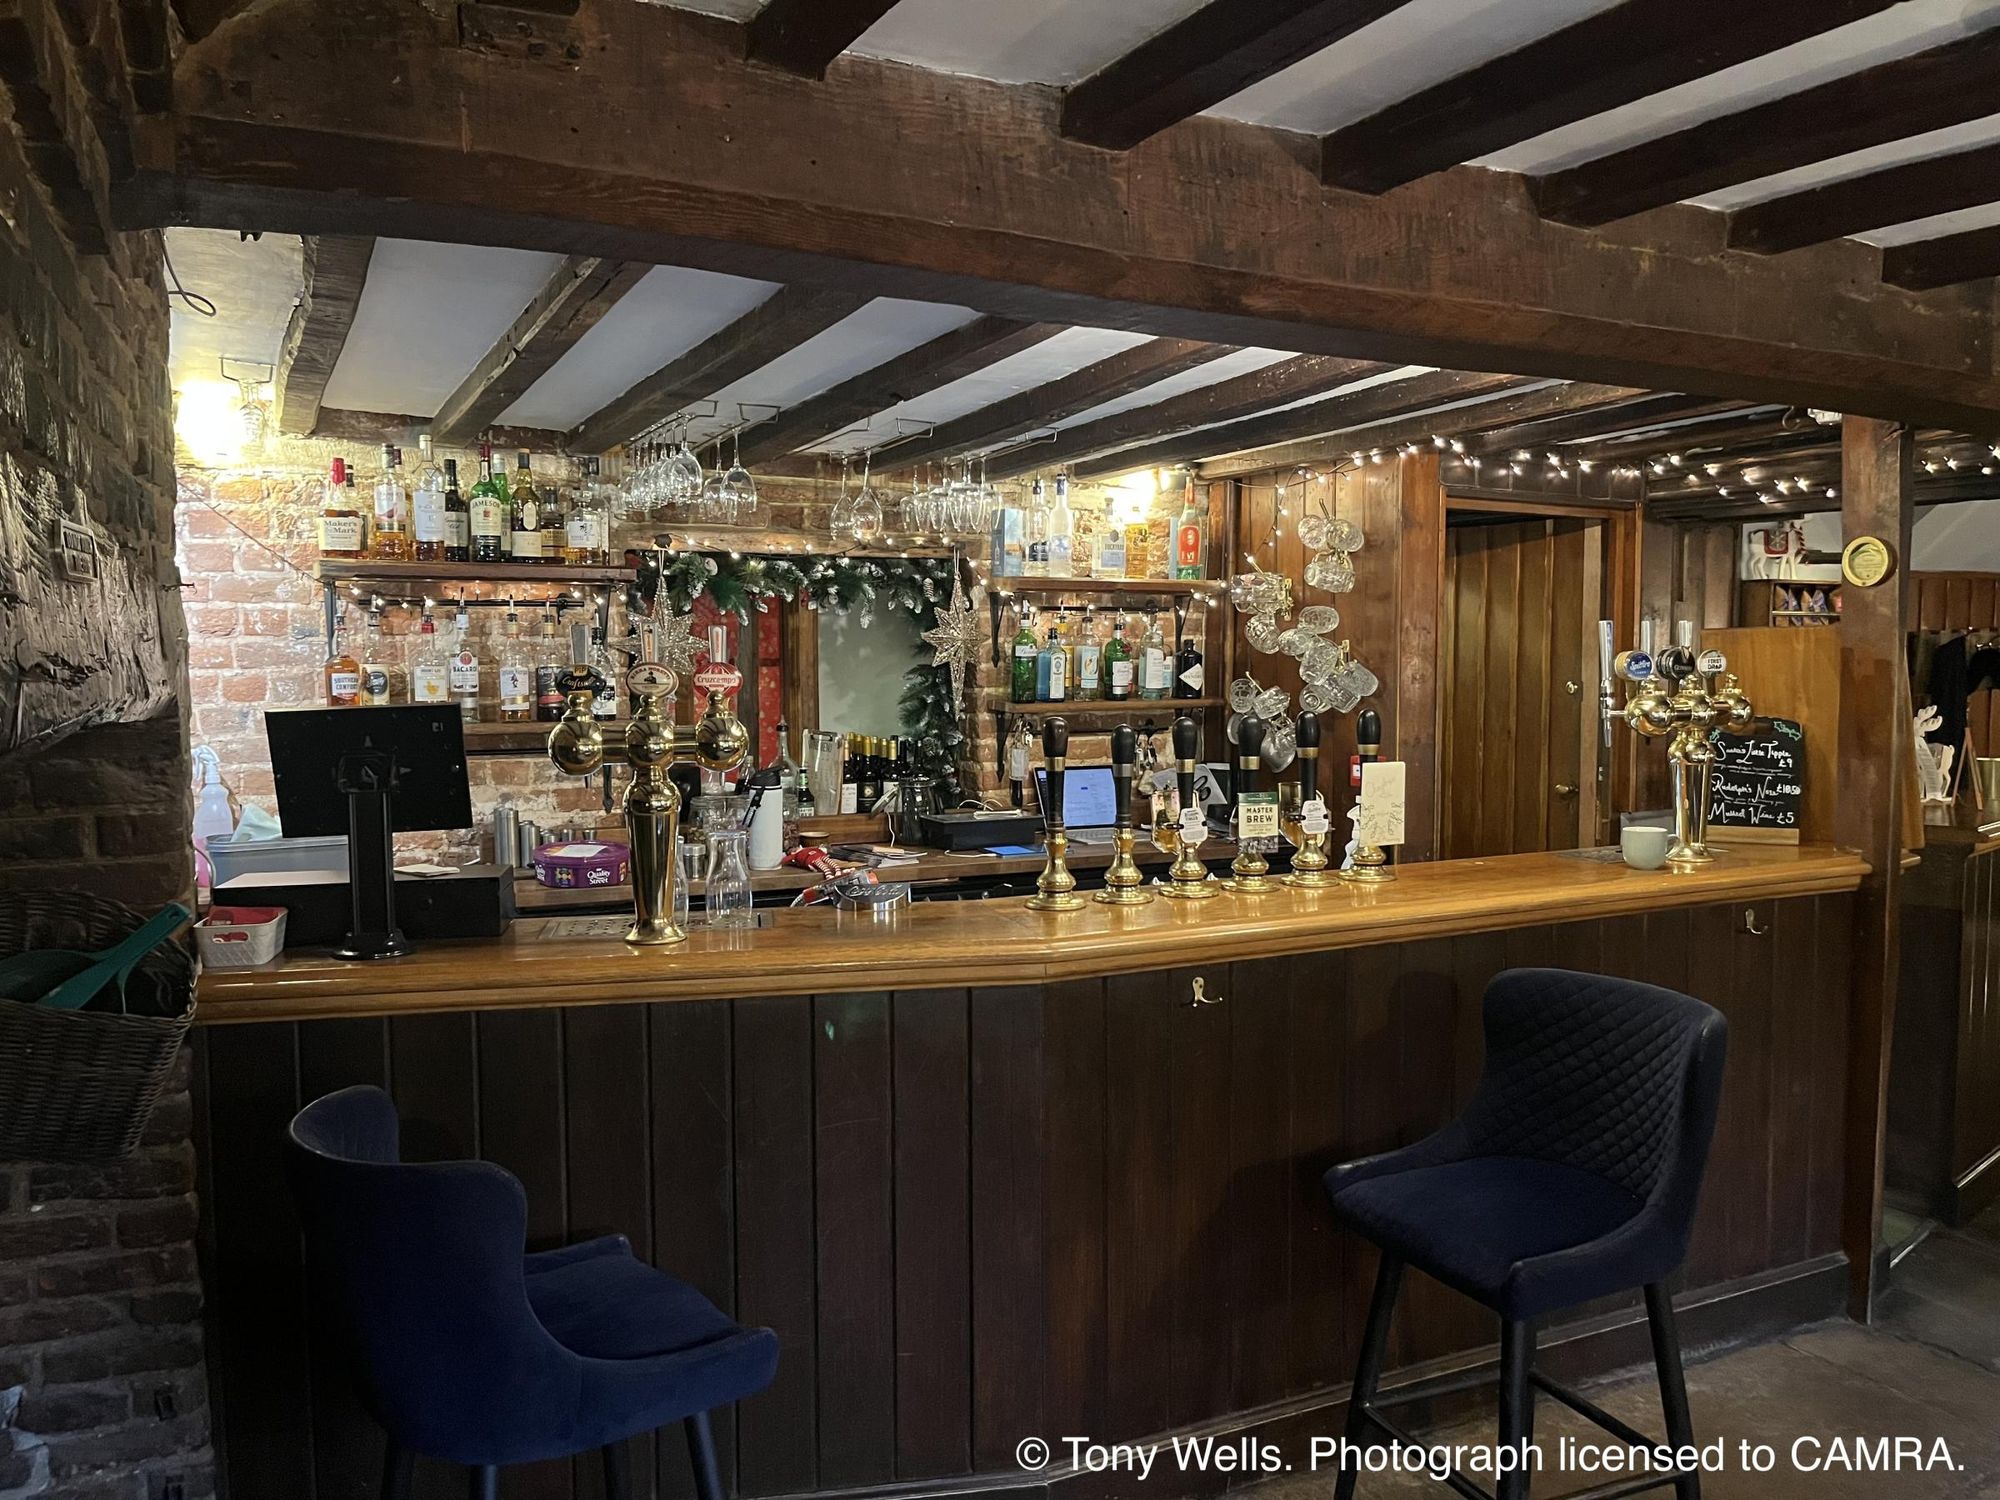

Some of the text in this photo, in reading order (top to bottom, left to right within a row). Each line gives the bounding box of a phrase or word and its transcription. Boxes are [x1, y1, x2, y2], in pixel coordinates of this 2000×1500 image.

[324, 520, 358, 528] Maker's
[697, 675, 737, 685] Cruzcampo
[1779, 758, 1793, 768] £9
[1246, 806, 1274, 815] MASTER
[1707, 802, 1794, 824] Mulled Wine £5
[1246, 815, 1273, 824] BREW
[586, 870, 611, 880] Quality
